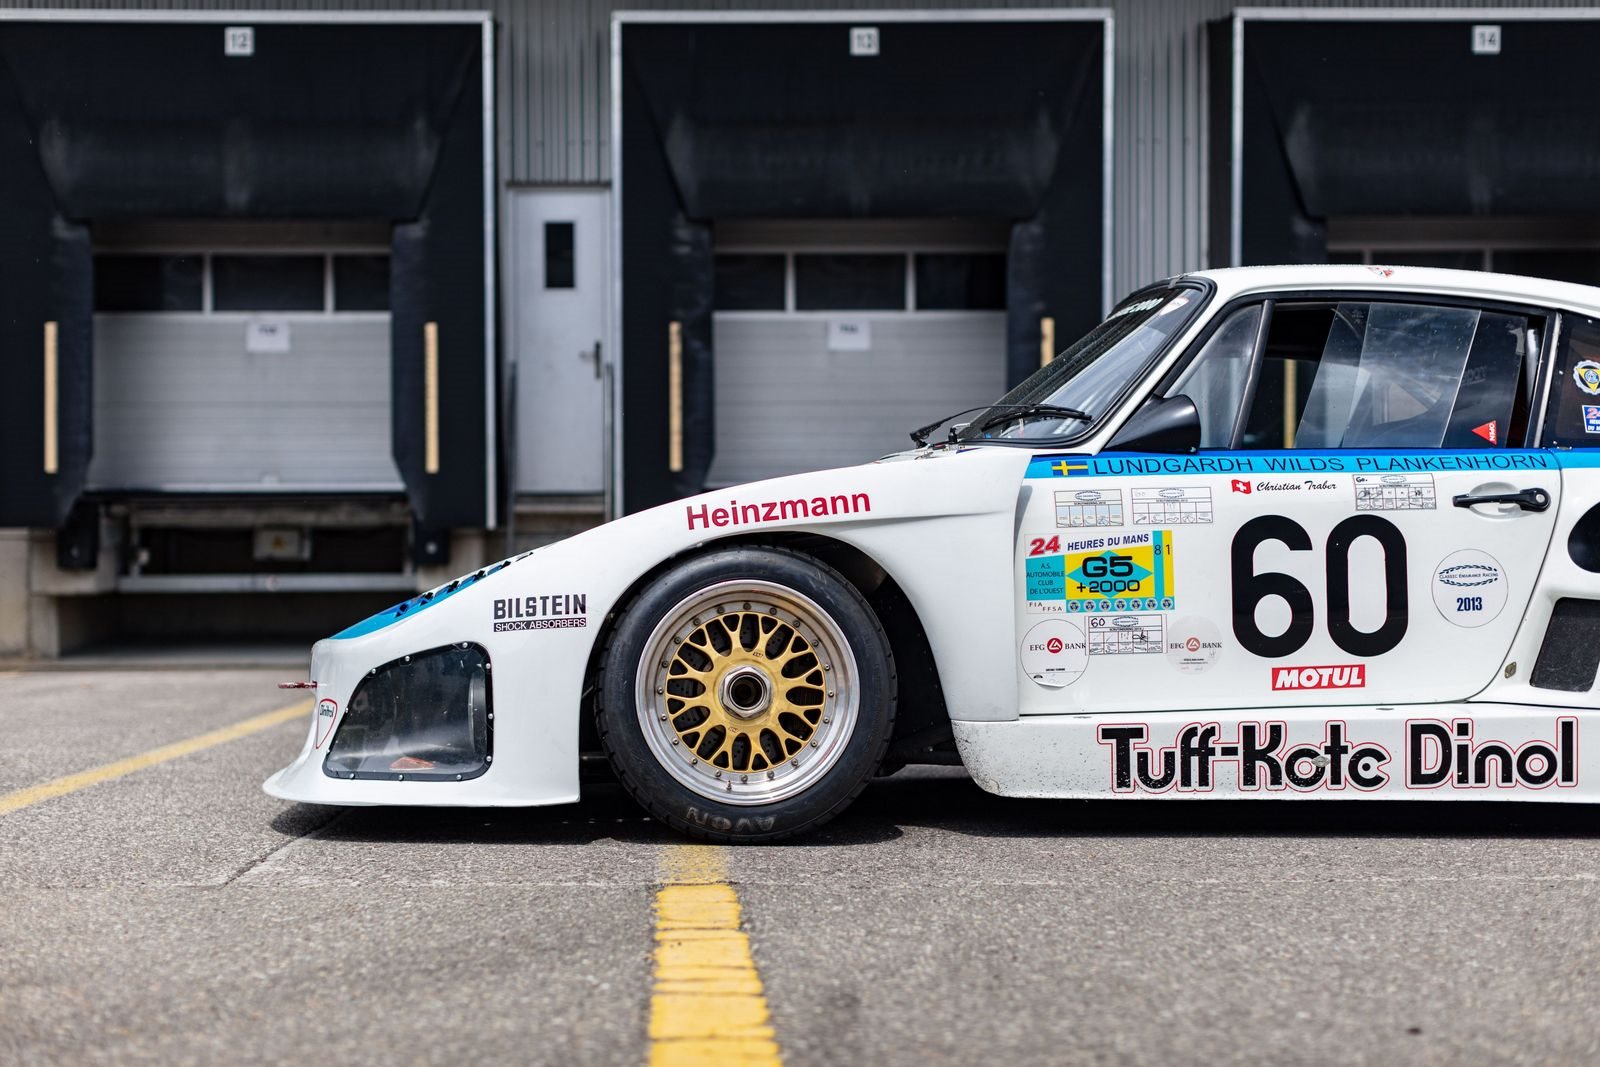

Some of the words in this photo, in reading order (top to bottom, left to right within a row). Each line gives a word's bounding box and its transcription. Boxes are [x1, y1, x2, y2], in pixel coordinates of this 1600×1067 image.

[1479, 31, 1497, 48] 14
[1488, 422, 1496, 441] OPEN
[1093, 457, 1253, 475] LUNDGARDH
[1263, 456, 1345, 472] WILDS
[1356, 454, 1548, 471] PLANKENHORN
[1256, 481, 1301, 492] Christian
[1304, 480, 1337, 490] Traber
[686, 492, 871, 530] Heinzmann
[1029, 535, 1061, 557] 24
[1067, 538, 1105, 552] HEURES
[1107, 536, 1121, 547] DU
[1122, 533, 1150, 545] MANS
[1026, 570, 1065, 578] AUTOMOBILE
[1082, 555, 1134, 578] G5
[1039, 587, 1063, 595] L'OUEST
[1076, 580, 1141, 594] +2000
[1231, 514, 1408, 659] 60
[493, 593, 587, 620] BILSTEIN
[1456, 596, 1483, 612] 2013
[495, 621, 527, 632] SHOCK
[529, 618, 587, 630] ABSORBERS
[1064, 642, 1086, 650] BANK
[1275, 666, 1363, 689] MOTUL
[1098, 719, 1390, 791] Tuff-Kote
[1408, 717, 1576, 788] Dinol
[686, 806, 778, 832] AVON
